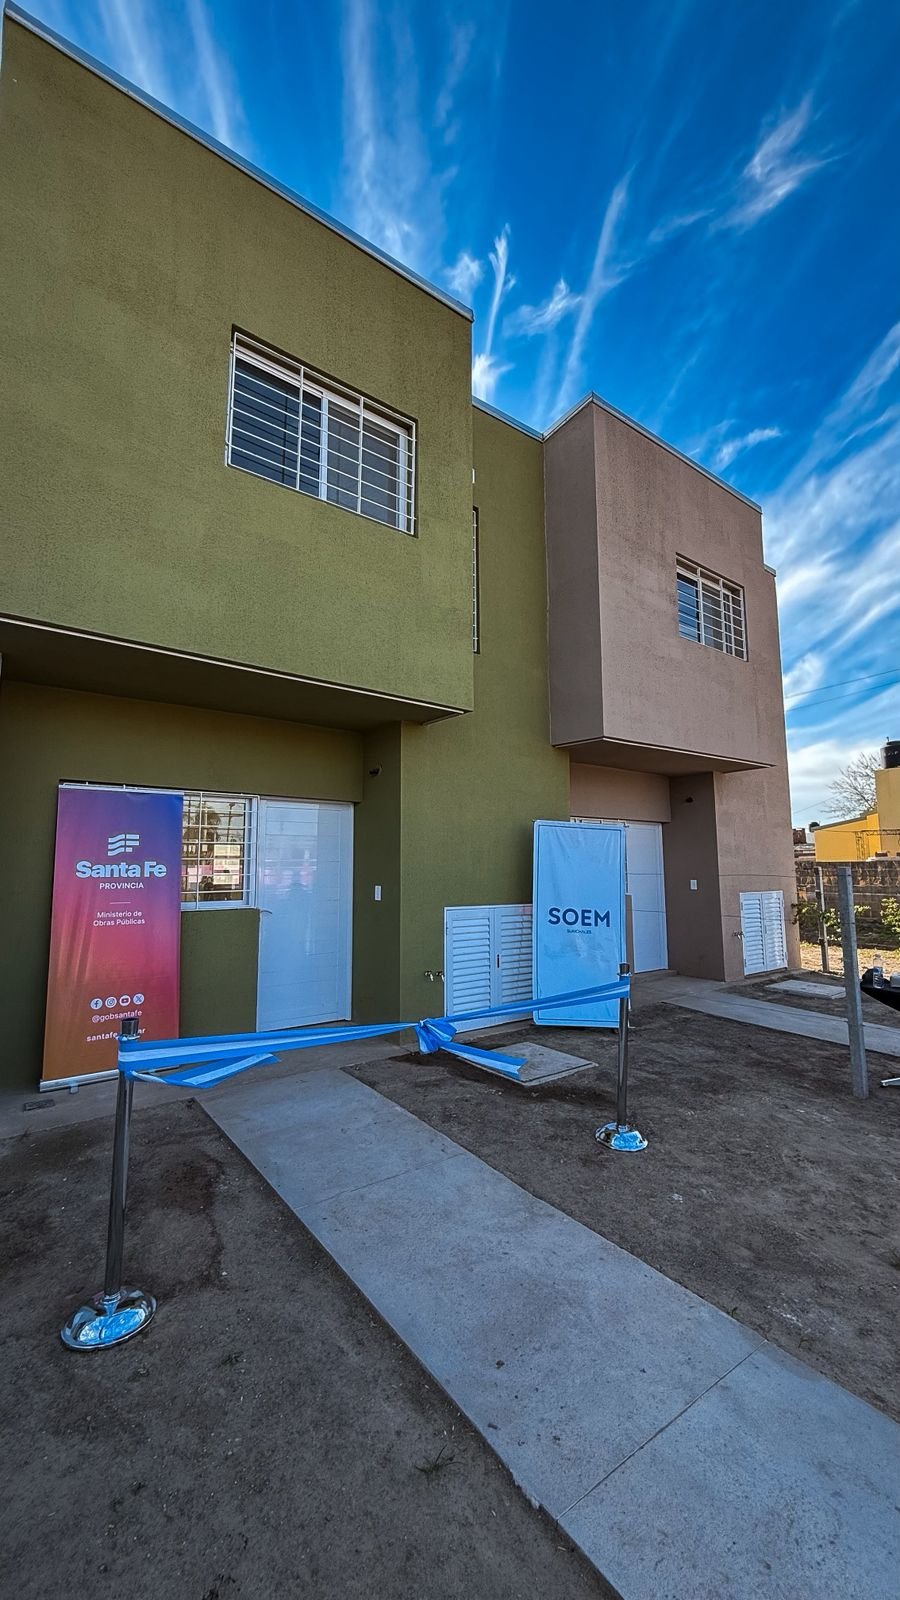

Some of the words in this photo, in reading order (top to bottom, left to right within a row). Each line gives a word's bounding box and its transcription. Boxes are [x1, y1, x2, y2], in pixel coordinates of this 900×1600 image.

[75, 860, 141, 878] Santa
[143, 860, 167, 878] Fe
[93, 919, 115, 927] Obras
[116, 918, 145, 926] Públicas
[548, 907, 611, 927] SOEM
[91, 1010, 143, 1023] @gobsantafe
